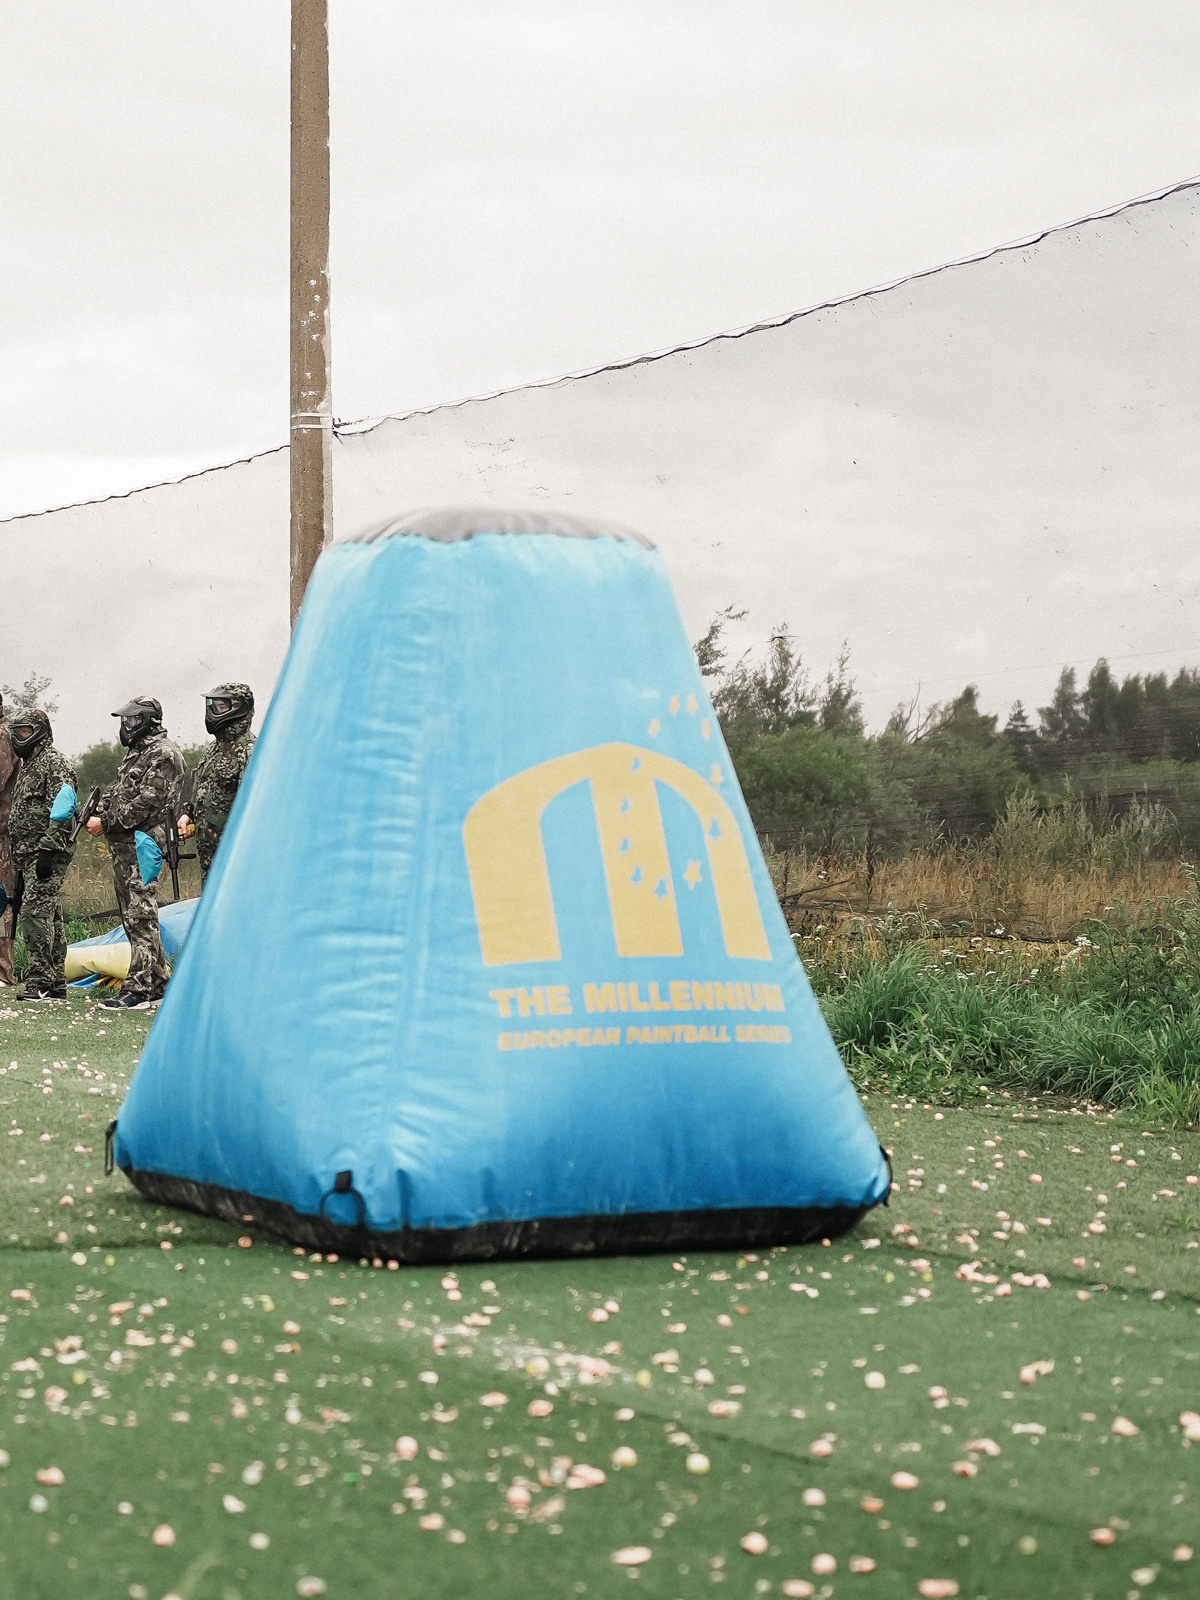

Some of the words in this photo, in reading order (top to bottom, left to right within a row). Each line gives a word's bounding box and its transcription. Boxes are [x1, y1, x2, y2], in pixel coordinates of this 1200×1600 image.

[490, 984, 573, 1018] THE
[584, 980, 786, 1012] MILLENNIUM
[499, 1026, 621, 1050] EUROPEAN
[626, 1024, 731, 1044] PAINTBALL
[735, 1024, 792, 1043] SERIES
